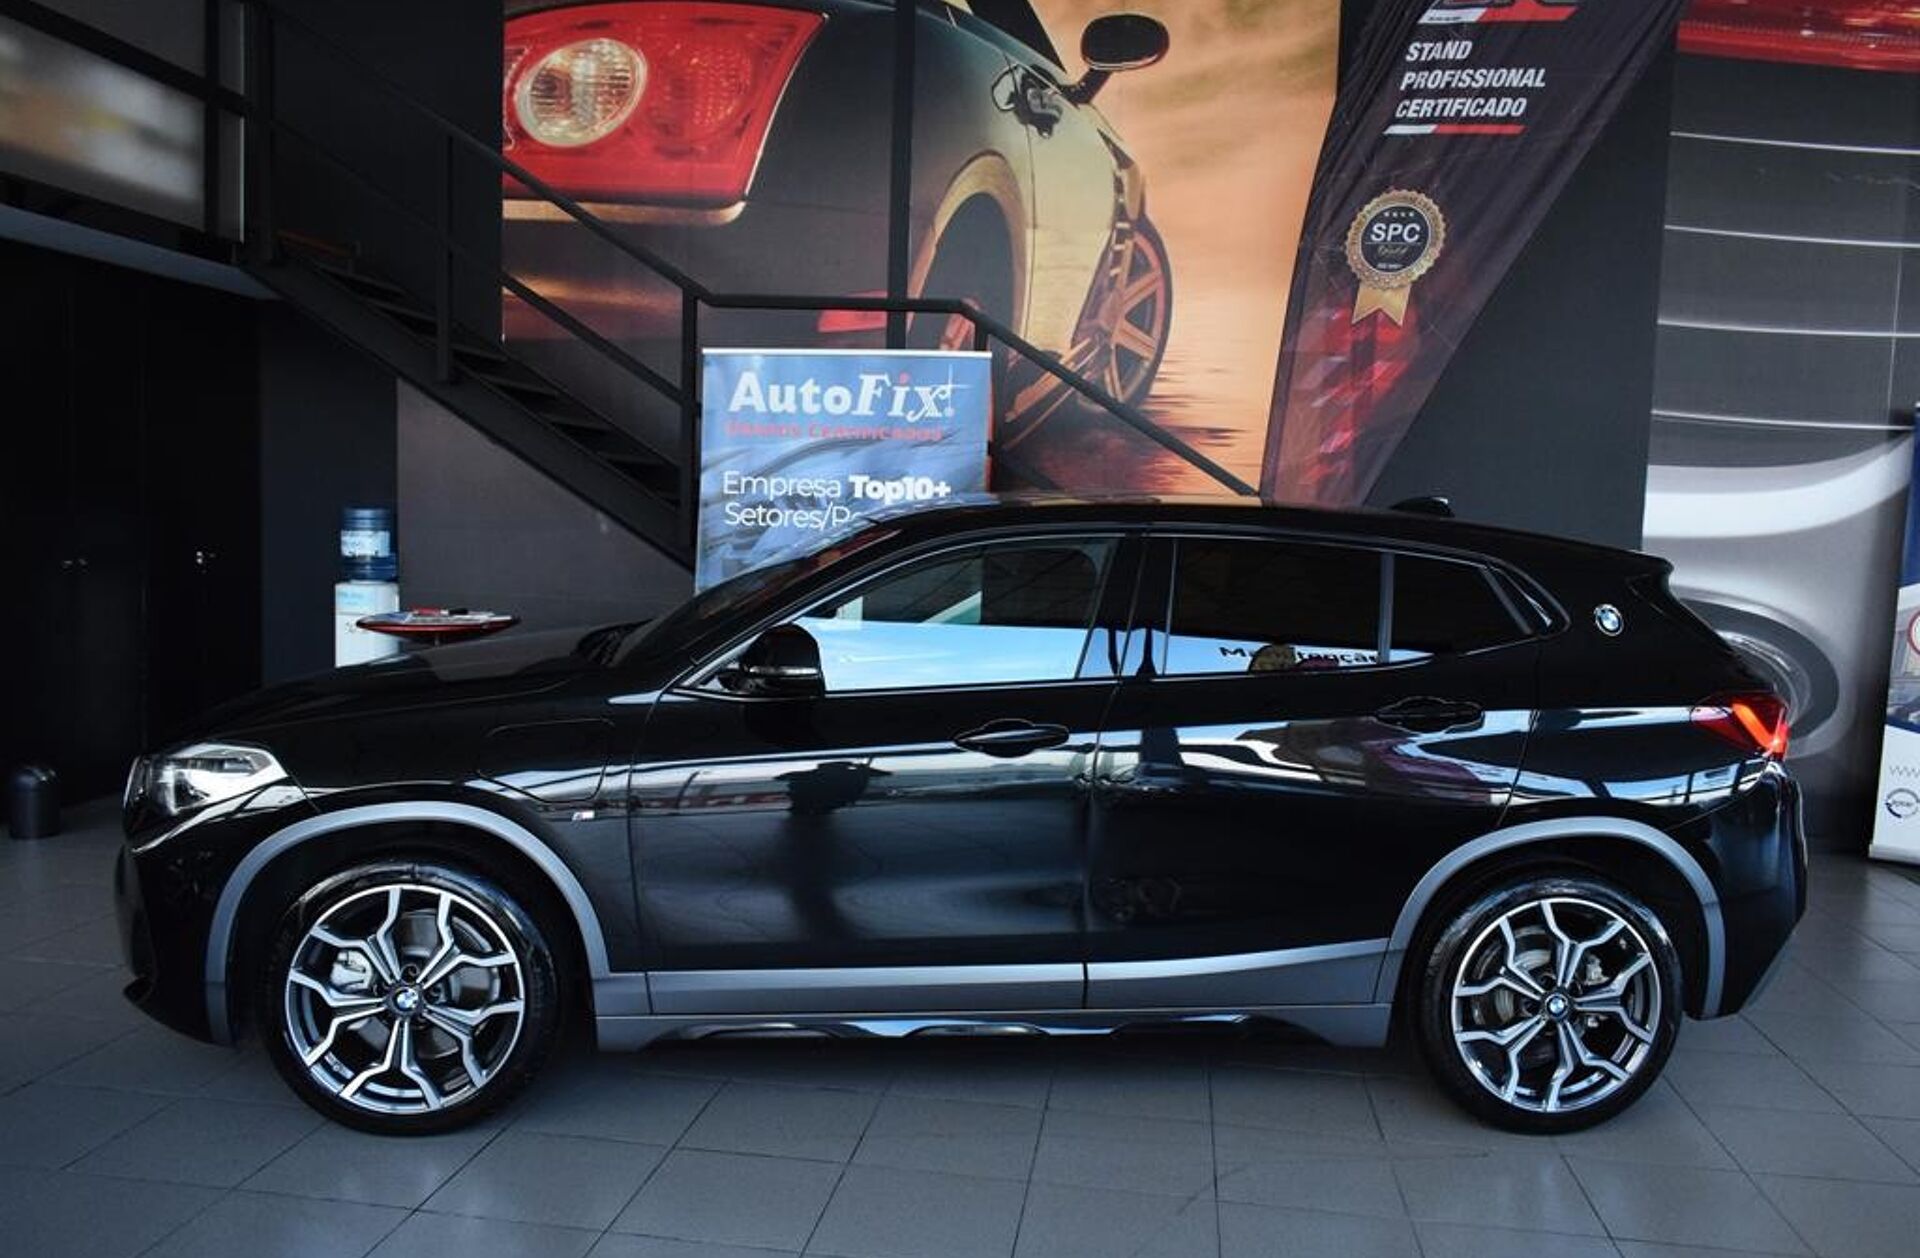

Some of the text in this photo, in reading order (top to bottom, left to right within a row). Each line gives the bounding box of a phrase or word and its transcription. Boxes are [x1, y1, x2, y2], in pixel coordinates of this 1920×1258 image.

[1405, 40, 1473, 61] STAND
[1400, 68, 1546, 91] PROFISSIONAL
[1394, 97, 1528, 118] CERTIFICADO
[1369, 222, 1421, 242] SPC
[722, 470, 952, 503] Empresa Top10+
